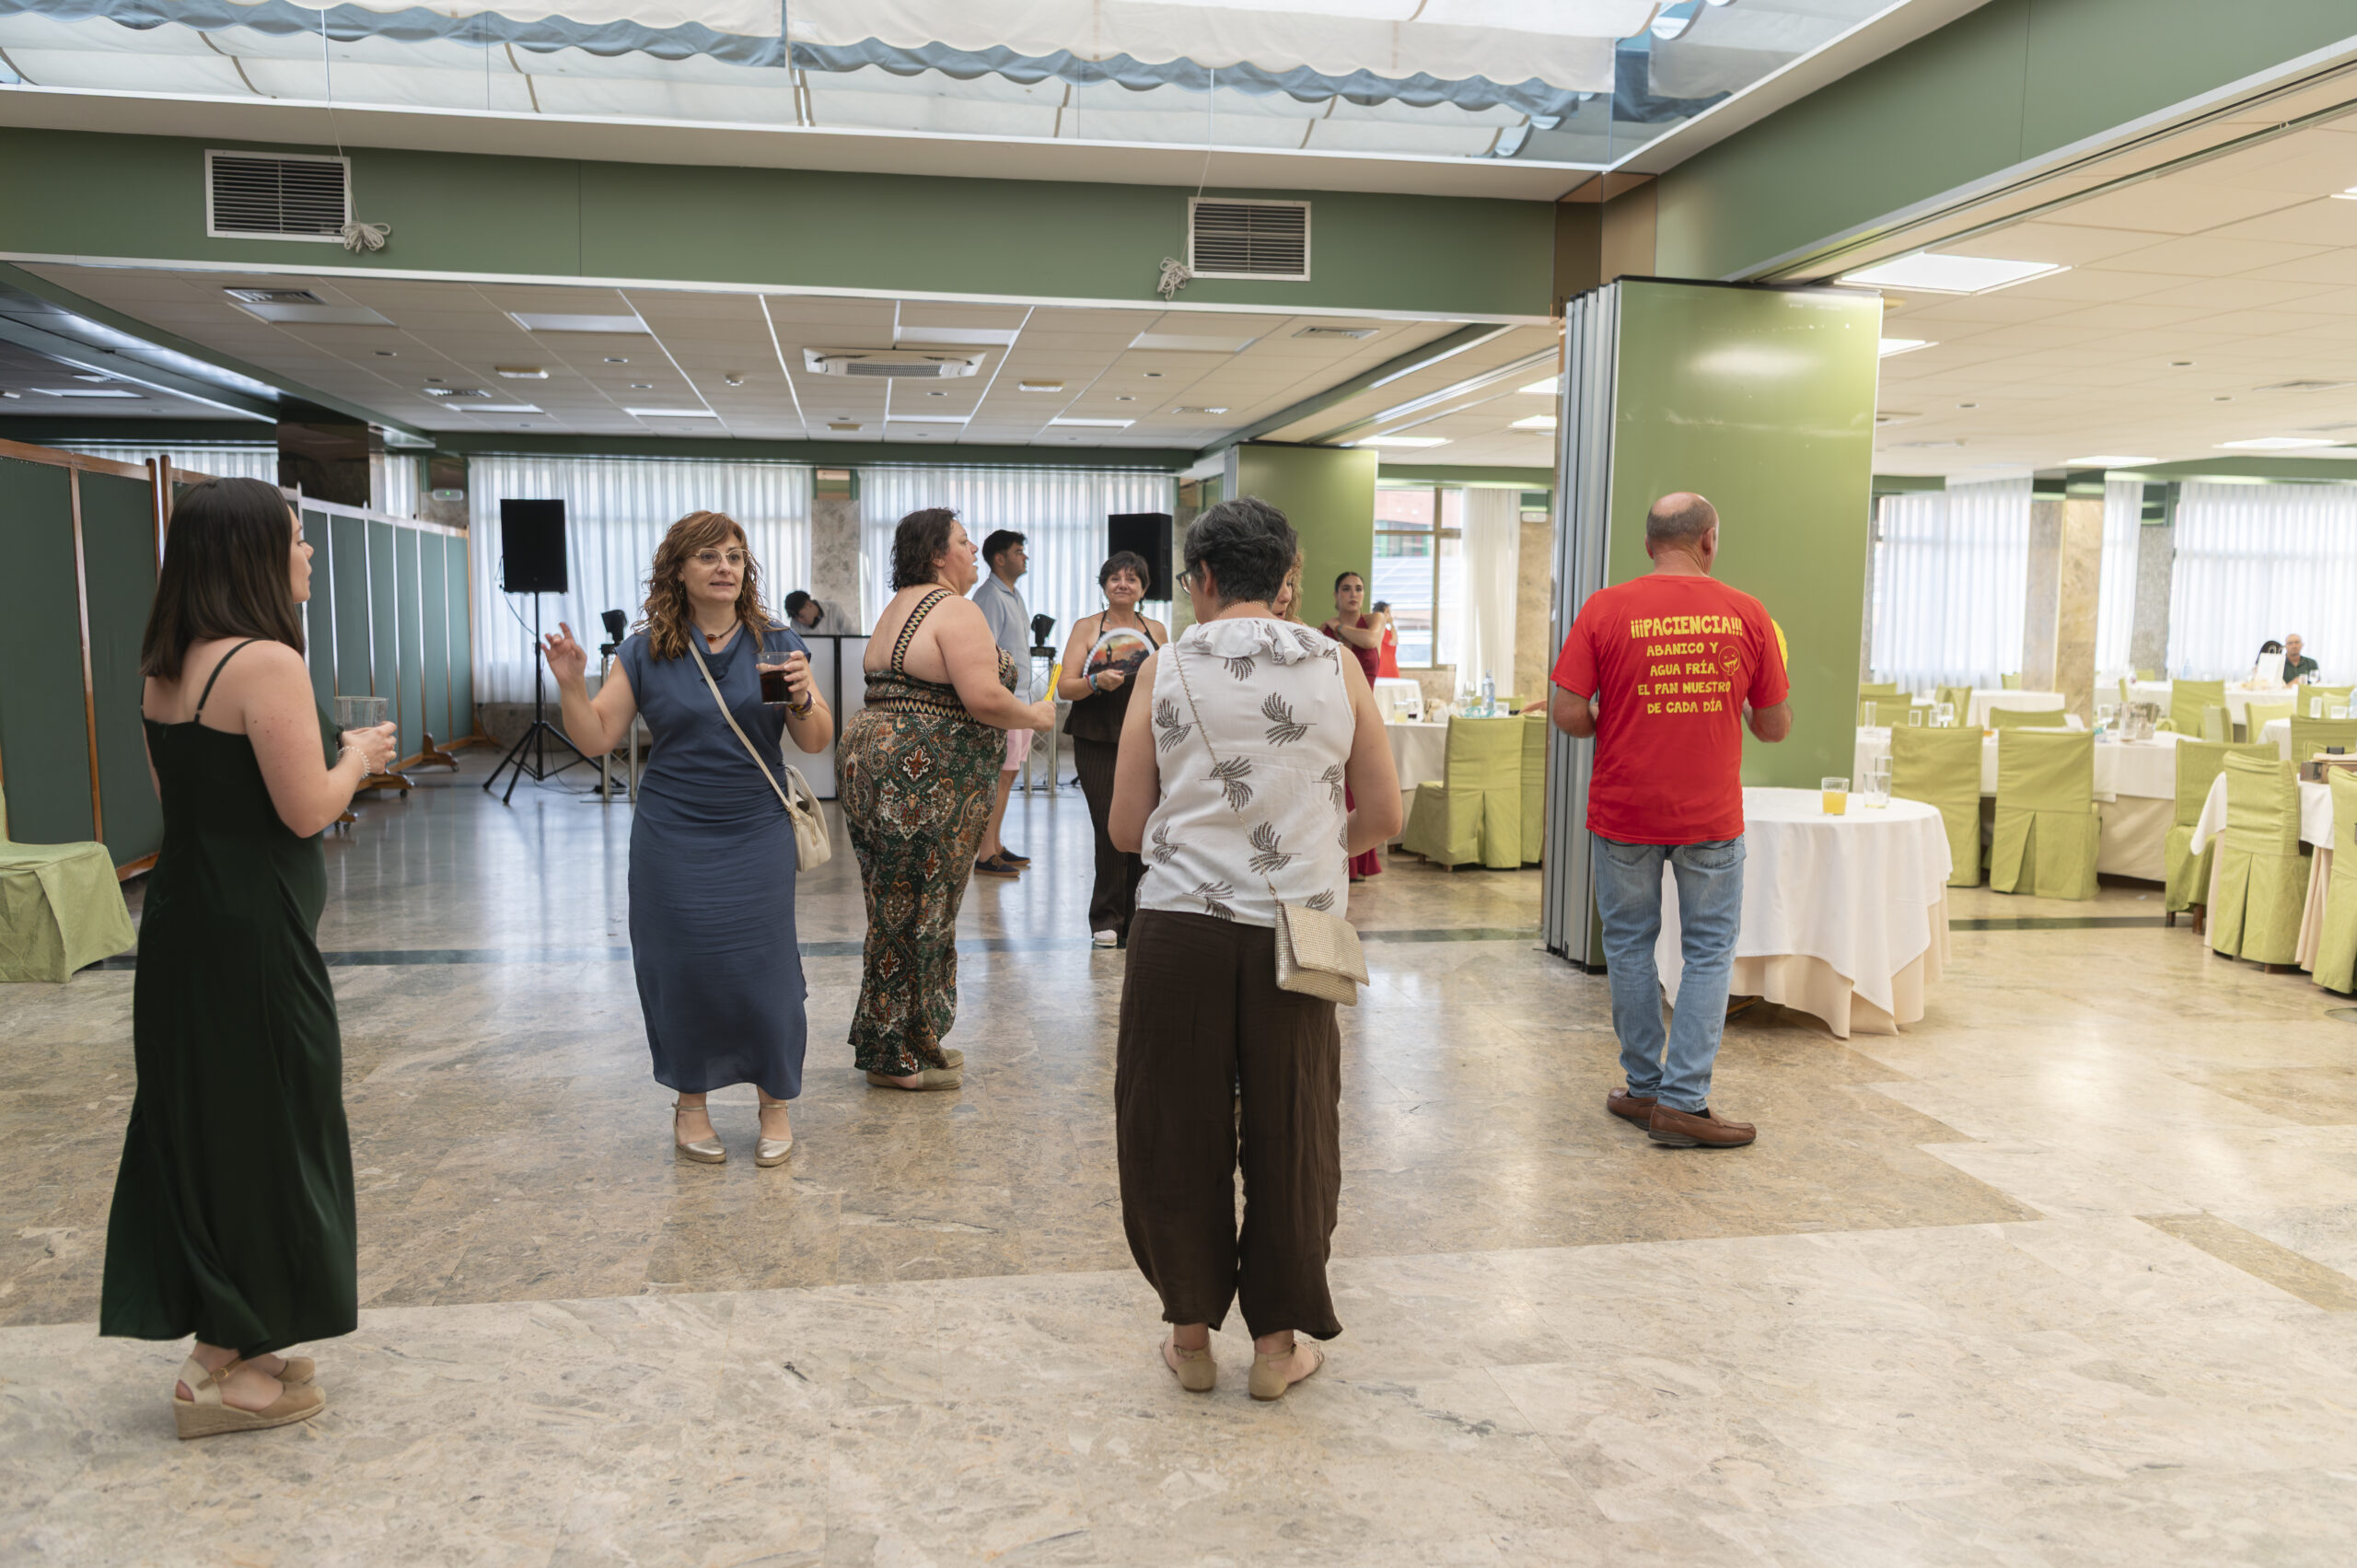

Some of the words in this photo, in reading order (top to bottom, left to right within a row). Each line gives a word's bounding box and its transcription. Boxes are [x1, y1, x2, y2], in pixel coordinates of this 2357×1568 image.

[1646, 642, 1704, 656] ABANICO
[1709, 642, 1719, 654] Y
[1650, 663, 1681, 677] AGUA
[1637, 684, 1650, 696] EL
[1655, 682, 1678, 695] PAN
[1682, 681, 1731, 694] NUESTRO
[1647, 703, 1662, 714] DE
[1666, 702, 1699, 714] CADA
[1702, 697, 1723, 713] DÍA
